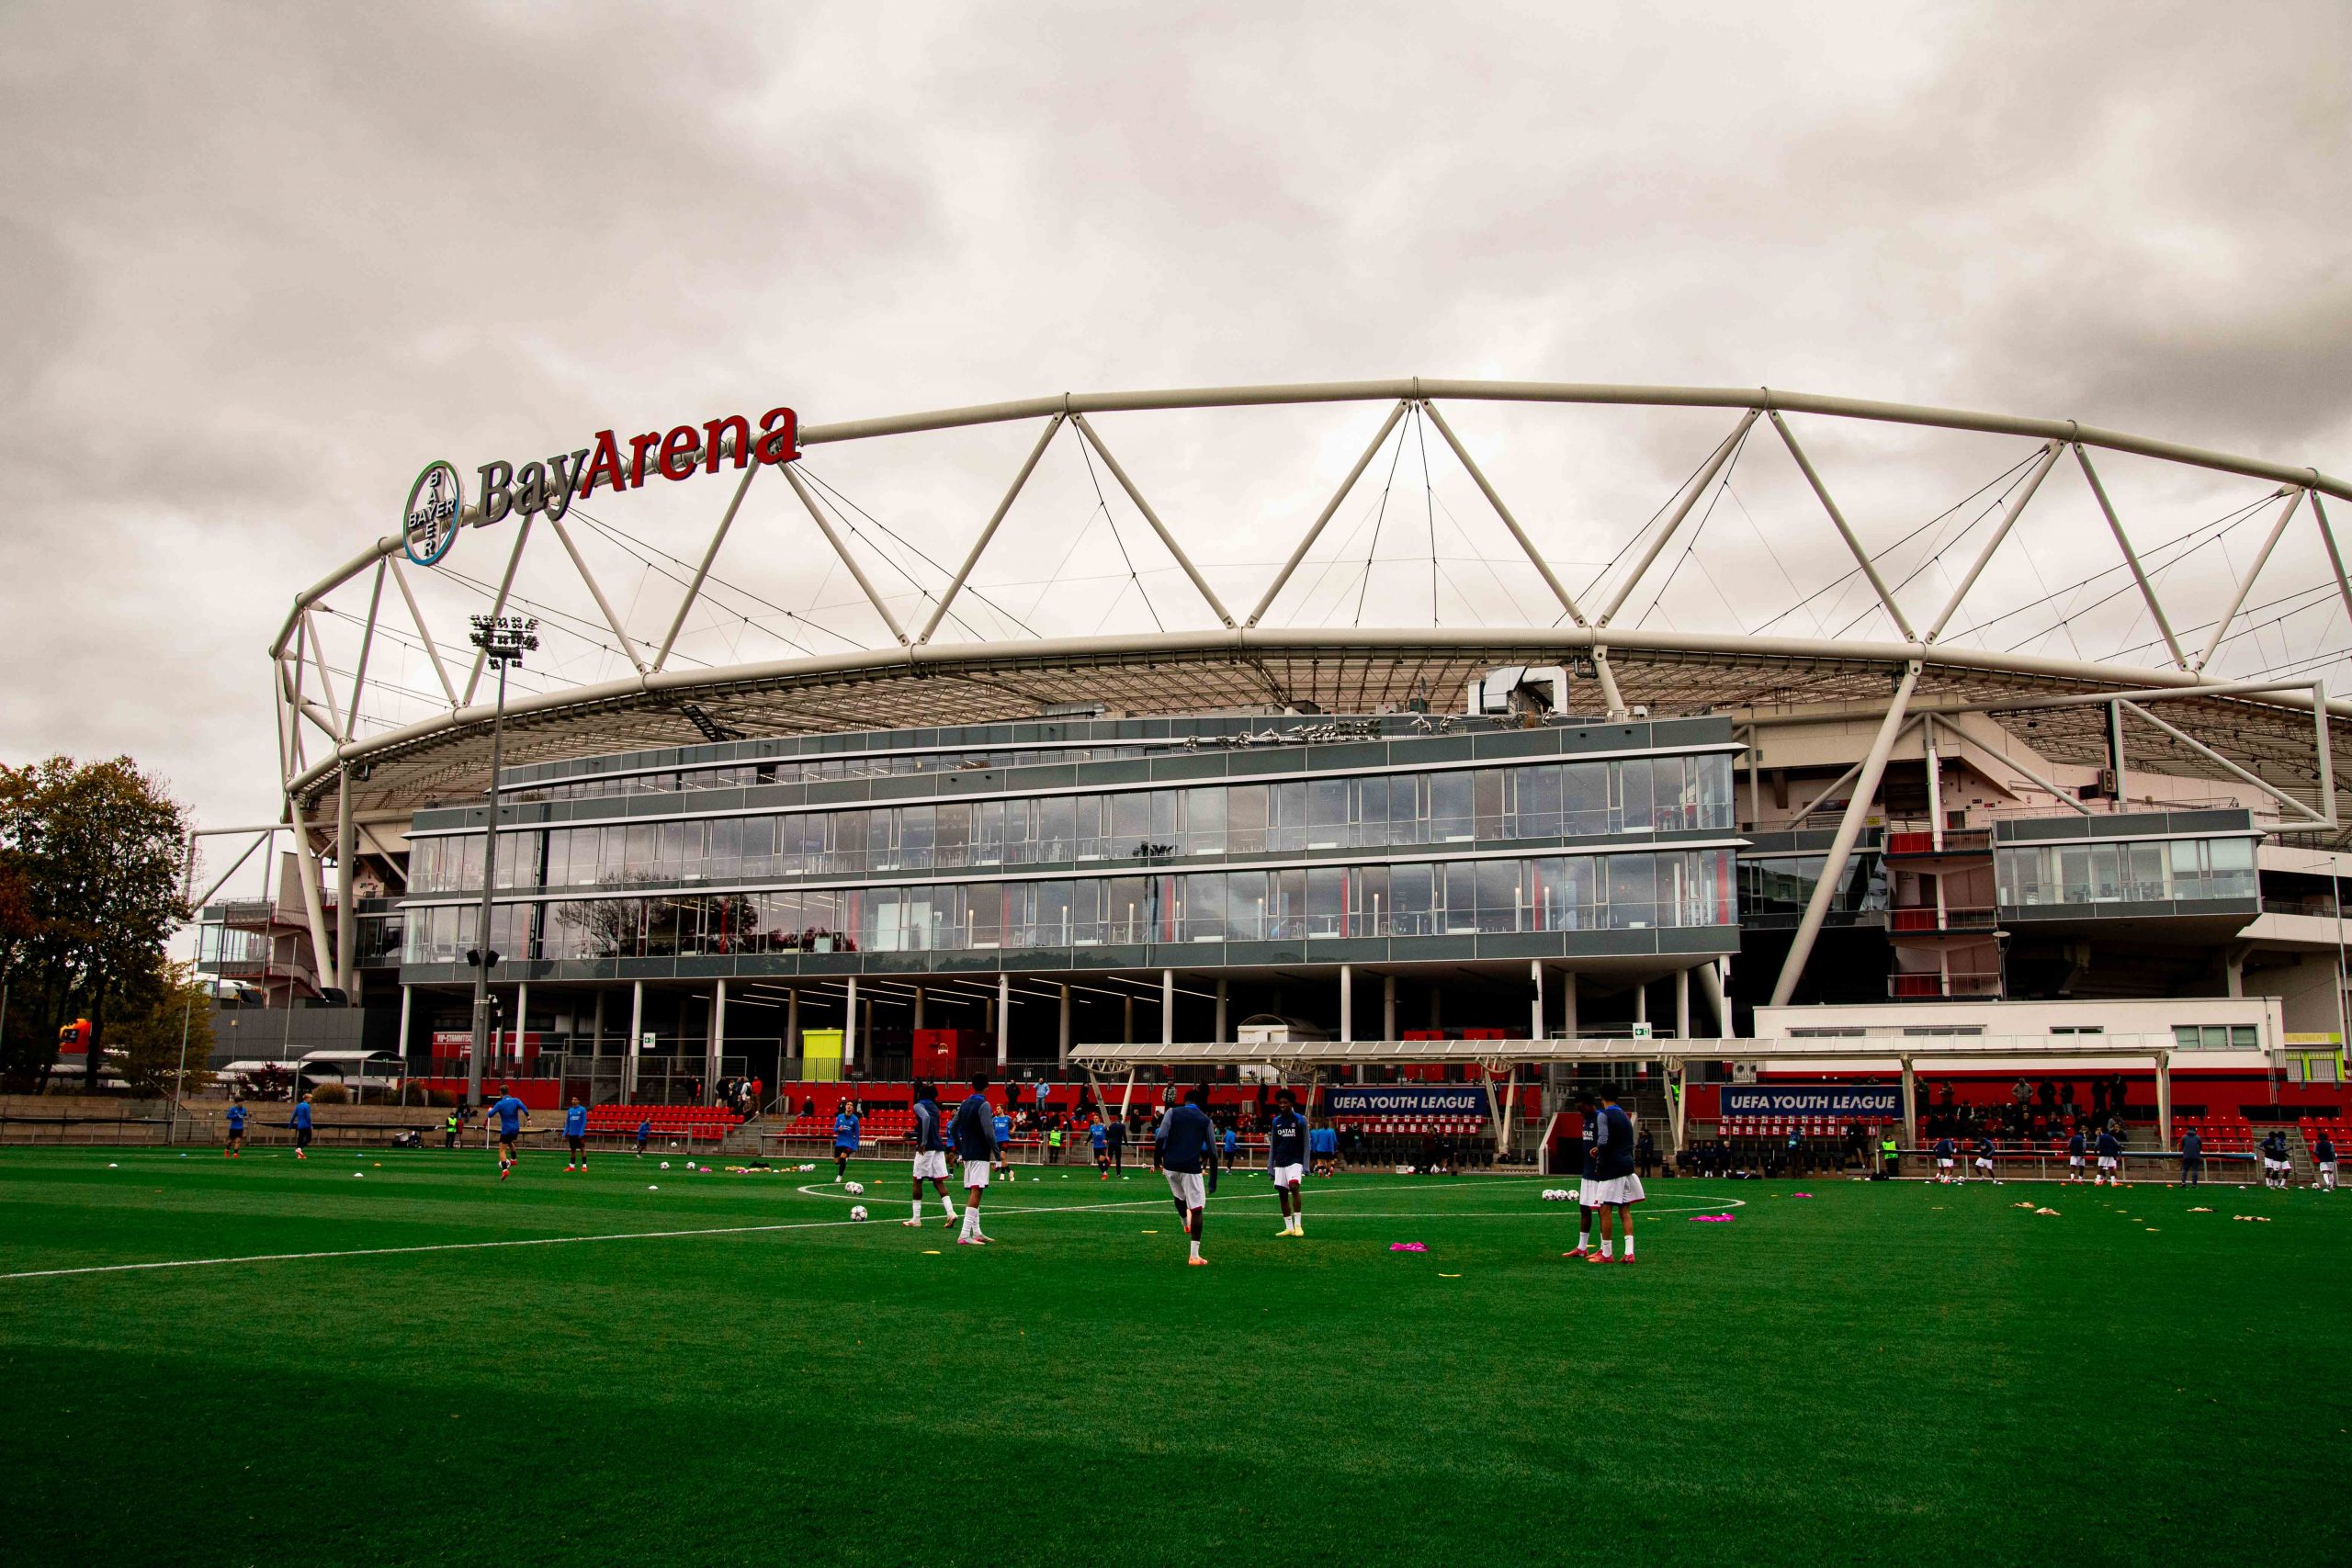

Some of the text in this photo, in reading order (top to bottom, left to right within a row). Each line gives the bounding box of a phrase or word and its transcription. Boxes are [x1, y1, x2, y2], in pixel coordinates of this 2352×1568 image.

[473, 407, 801, 528] BayArena
[409, 498, 456, 528] BAYER
[424, 471, 441, 557] BAYER
[437, 1034, 472, 1043] VIP-STAMMTISC
[1333, 1096, 1476, 1109] UEFA YOUTH LEAGUE
[1731, 1096, 1895, 1109] UEFA YOUTH LEAGUE
